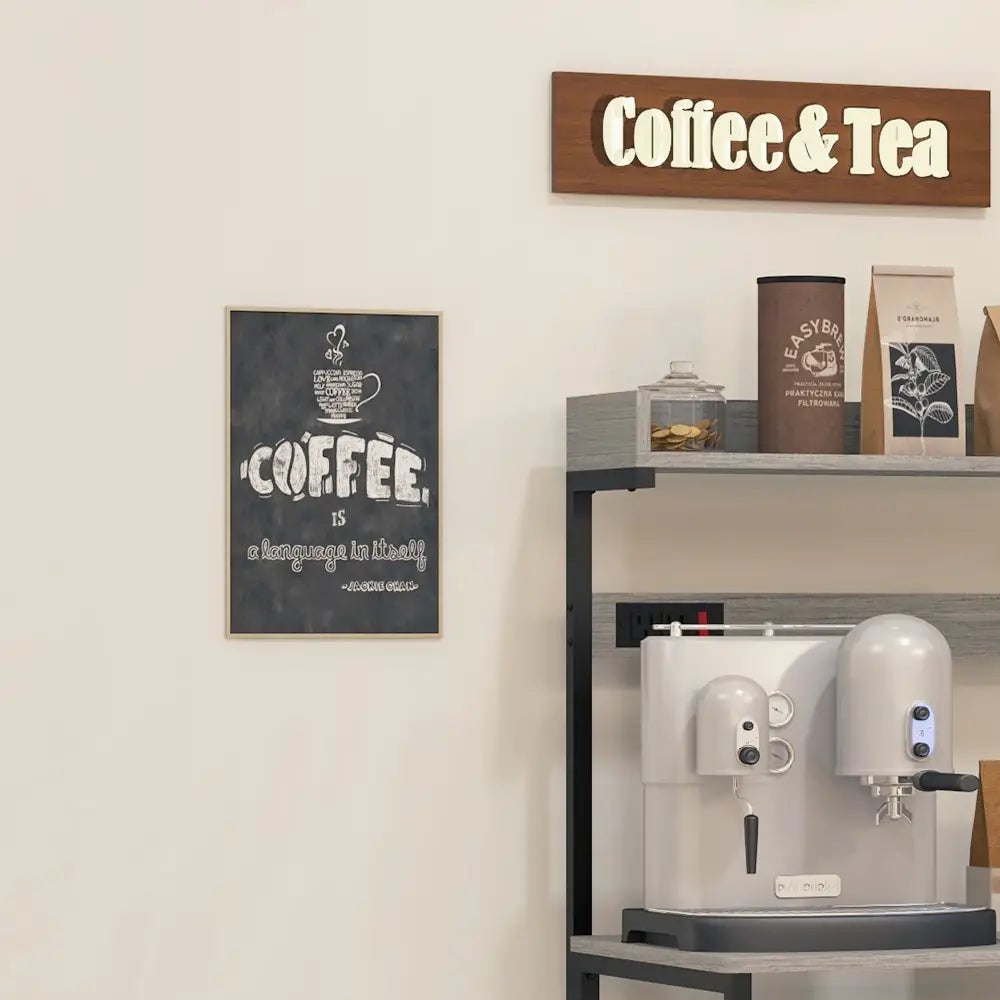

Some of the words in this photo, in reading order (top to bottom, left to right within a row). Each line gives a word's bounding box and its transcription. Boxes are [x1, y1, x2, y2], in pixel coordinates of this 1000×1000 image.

[603, 96, 784, 172] Coffee
[788, 103, 839, 174] &
[843, 107, 950, 178] Tea
[248, 435, 422, 502] COFFEE
[331, 509, 346, 527] IS
[247, 545, 259, 560] a
[261, 538, 348, 572] language
[350, 540, 370, 561] in
[372, 538, 427, 572] itself
